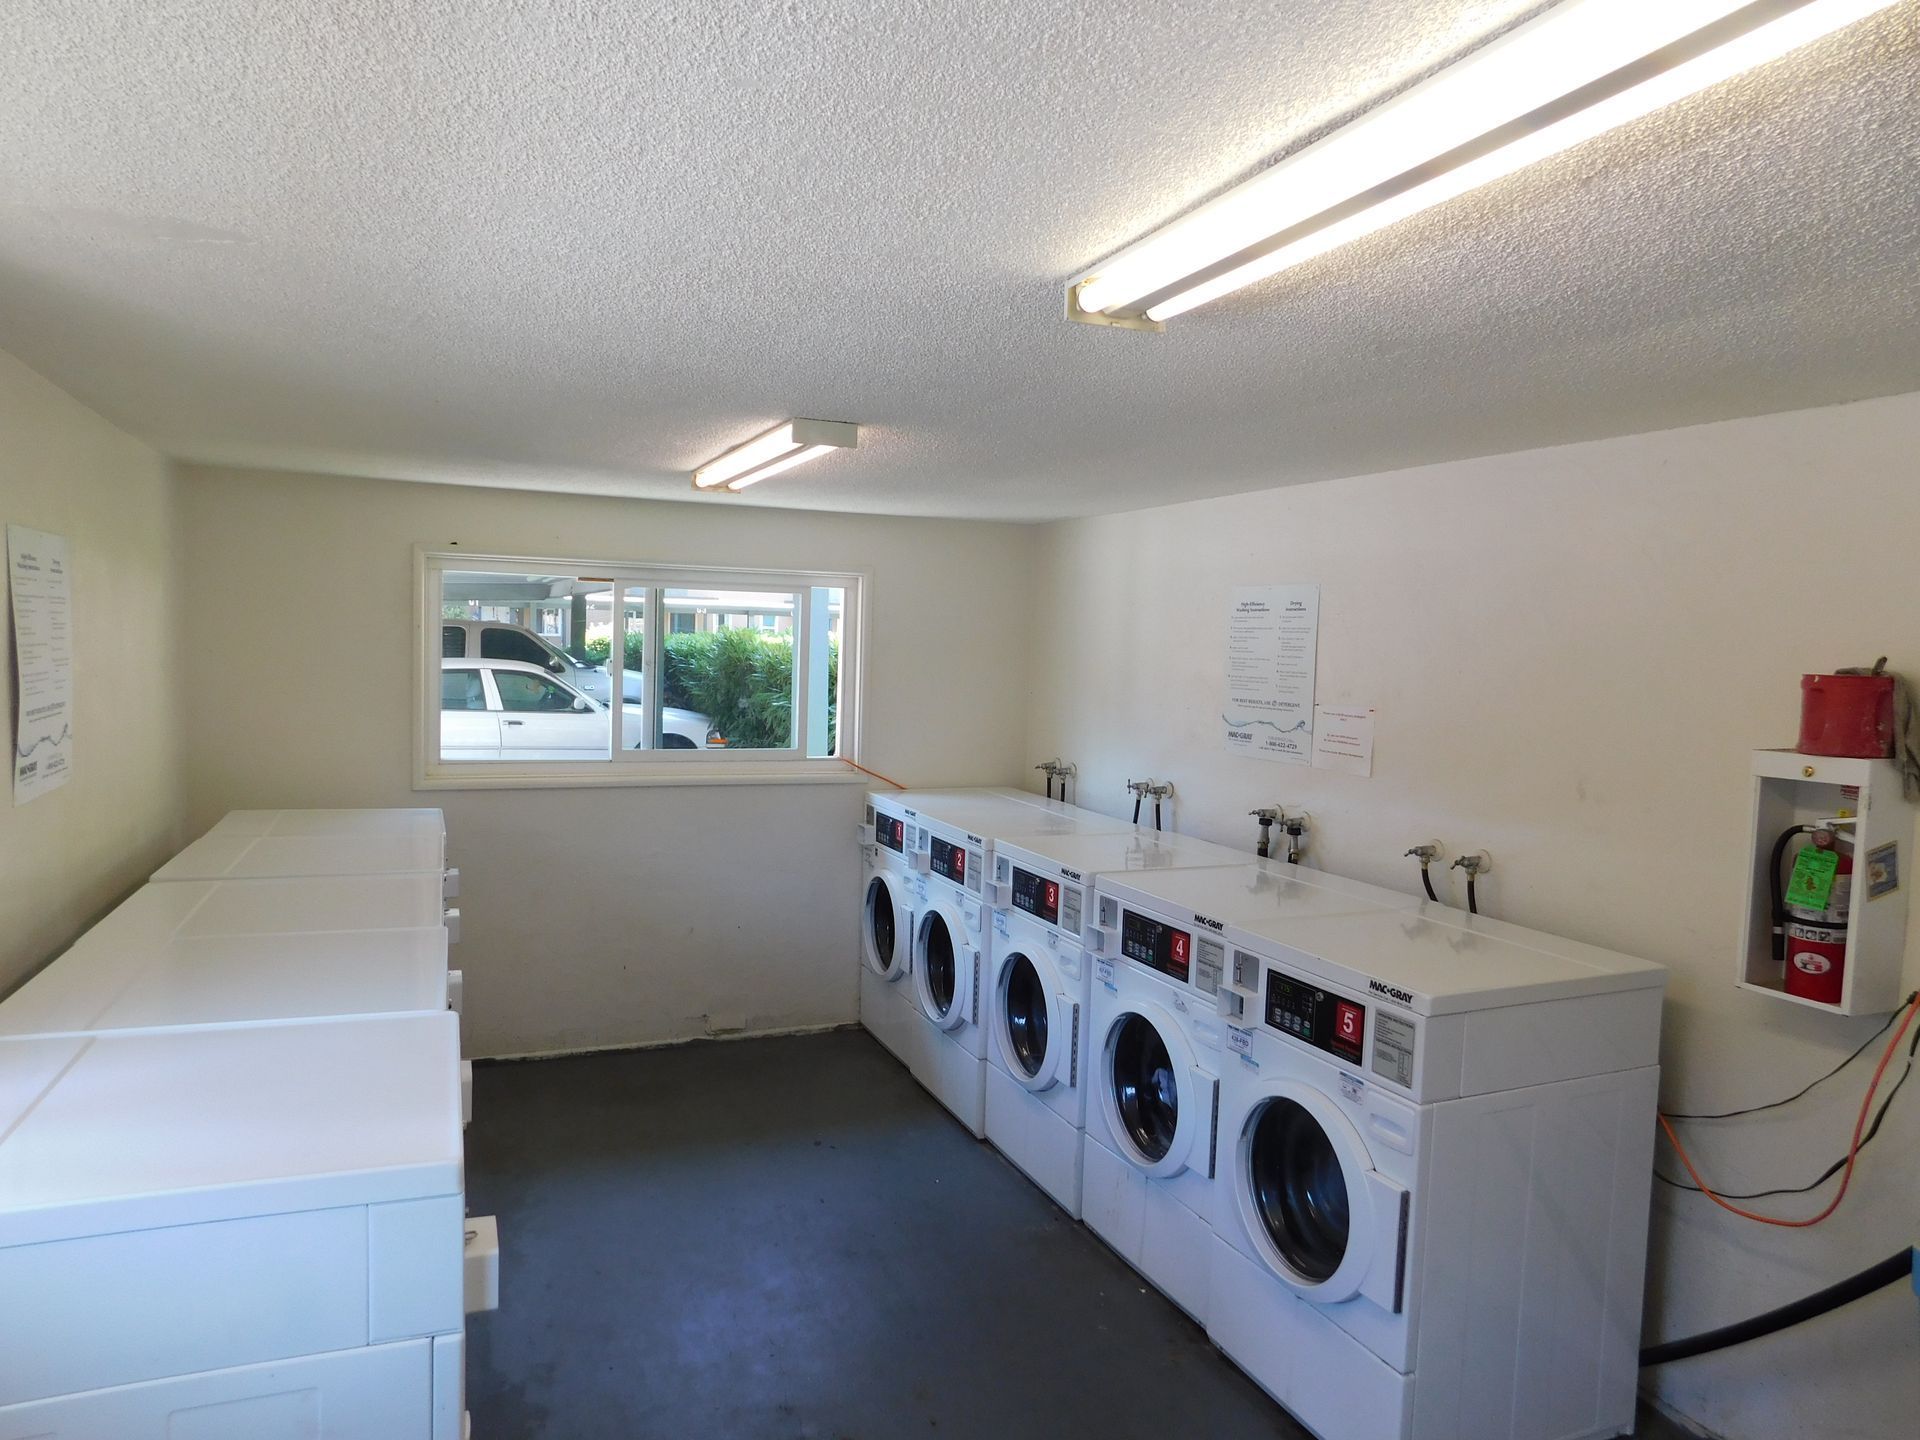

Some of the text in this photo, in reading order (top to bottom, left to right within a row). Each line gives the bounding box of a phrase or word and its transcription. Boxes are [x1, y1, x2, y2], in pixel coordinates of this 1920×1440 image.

[957, 853, 962, 866] 2
[1048, 887, 1055, 903] 3
[1175, 939, 1184, 957] 4
[1342, 1011, 1354, 1034] 5
